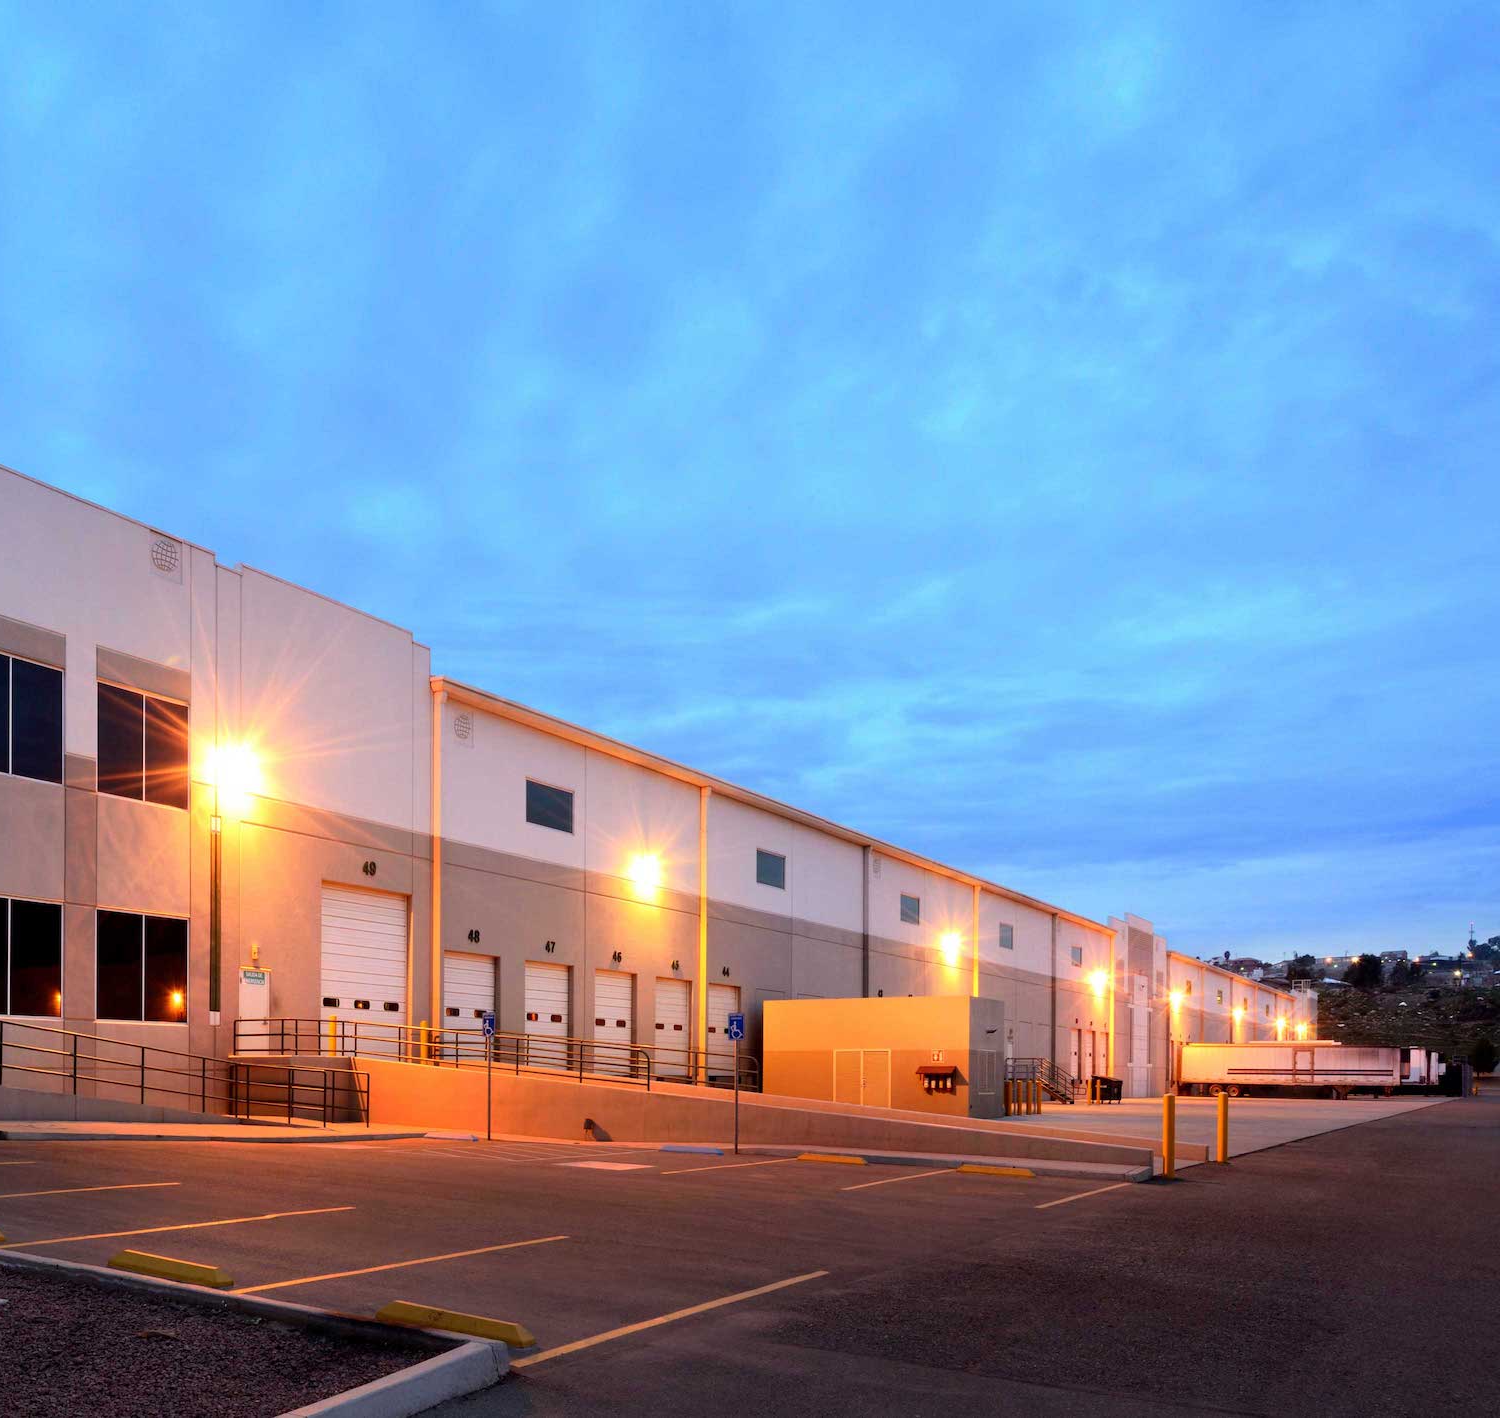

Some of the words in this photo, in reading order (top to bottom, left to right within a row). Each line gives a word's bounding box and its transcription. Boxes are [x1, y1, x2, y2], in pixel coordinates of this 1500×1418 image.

[362, 861, 376, 876] 49
[467, 929, 480, 943] 48
[545, 940, 556, 953] 47
[612, 950, 622, 962] 46
[671, 960, 679, 970] 45
